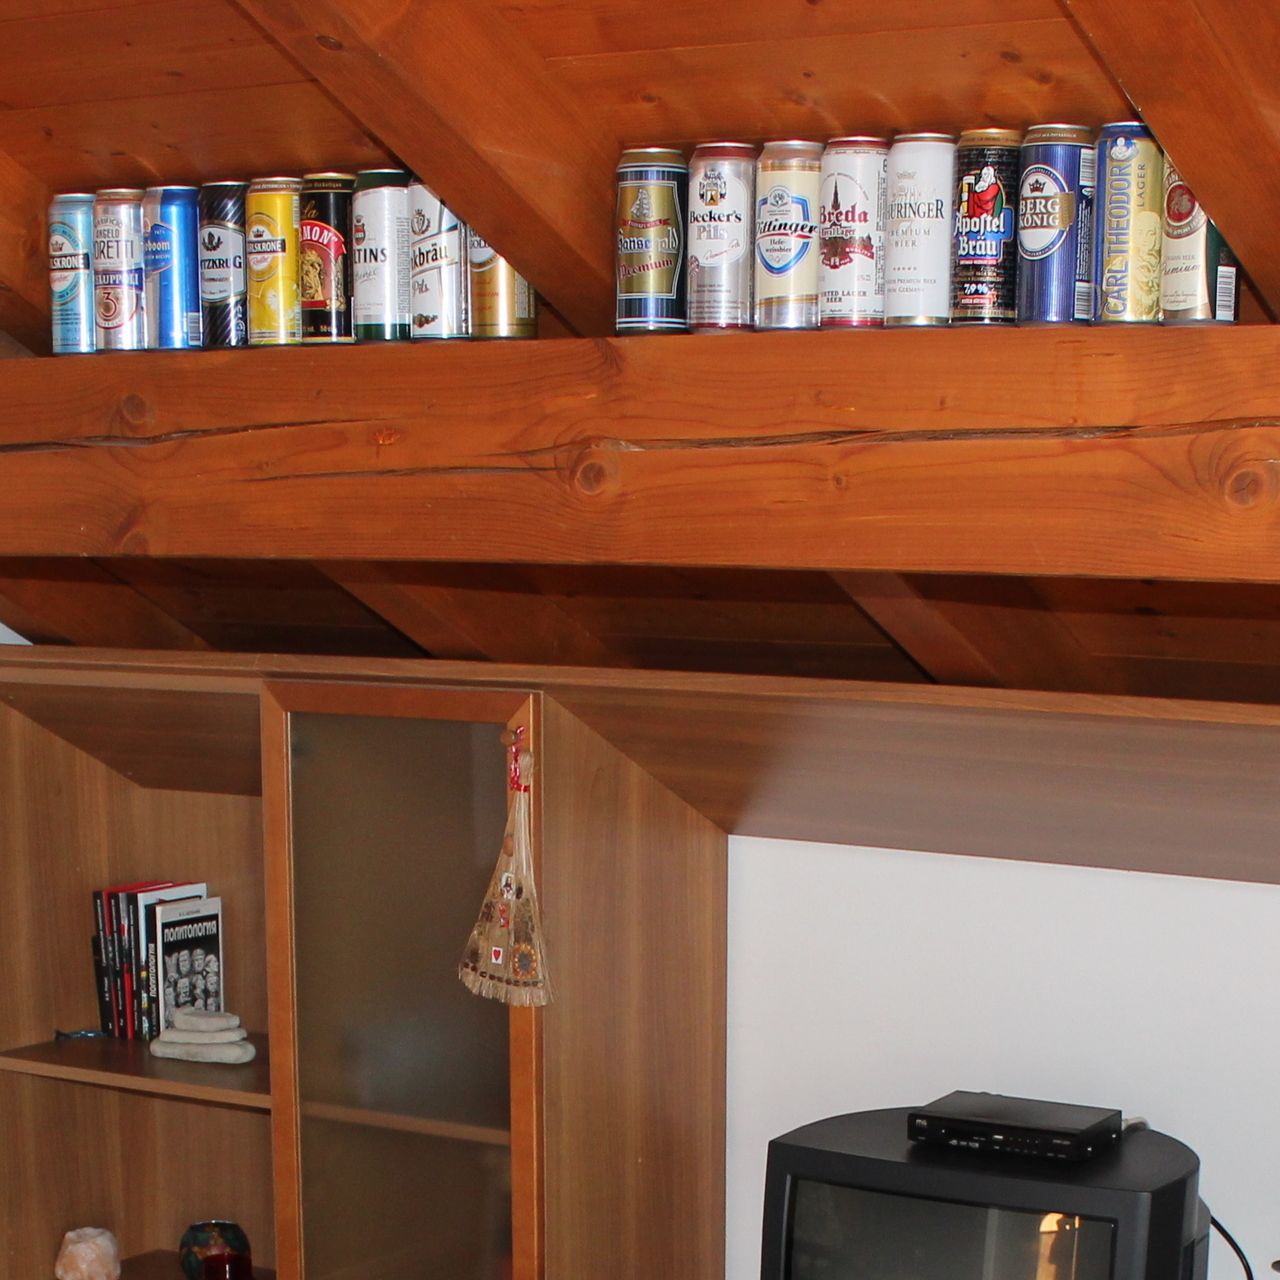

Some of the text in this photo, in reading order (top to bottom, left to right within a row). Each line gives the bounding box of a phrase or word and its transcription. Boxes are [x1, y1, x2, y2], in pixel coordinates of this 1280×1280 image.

[1136, 163, 1147, 208] LAGER
[689, 210, 743, 224] Becker's
[1020, 199, 1060, 214] BERG
[696, 224, 728, 240] Pils
[1104, 163, 1132, 315] CARL THEODOR
[957, 235, 997, 257] Bräu
[102, 291, 117, 317] 3
[164, 920, 217, 943] ПОЛИТОЛОГИЯ
